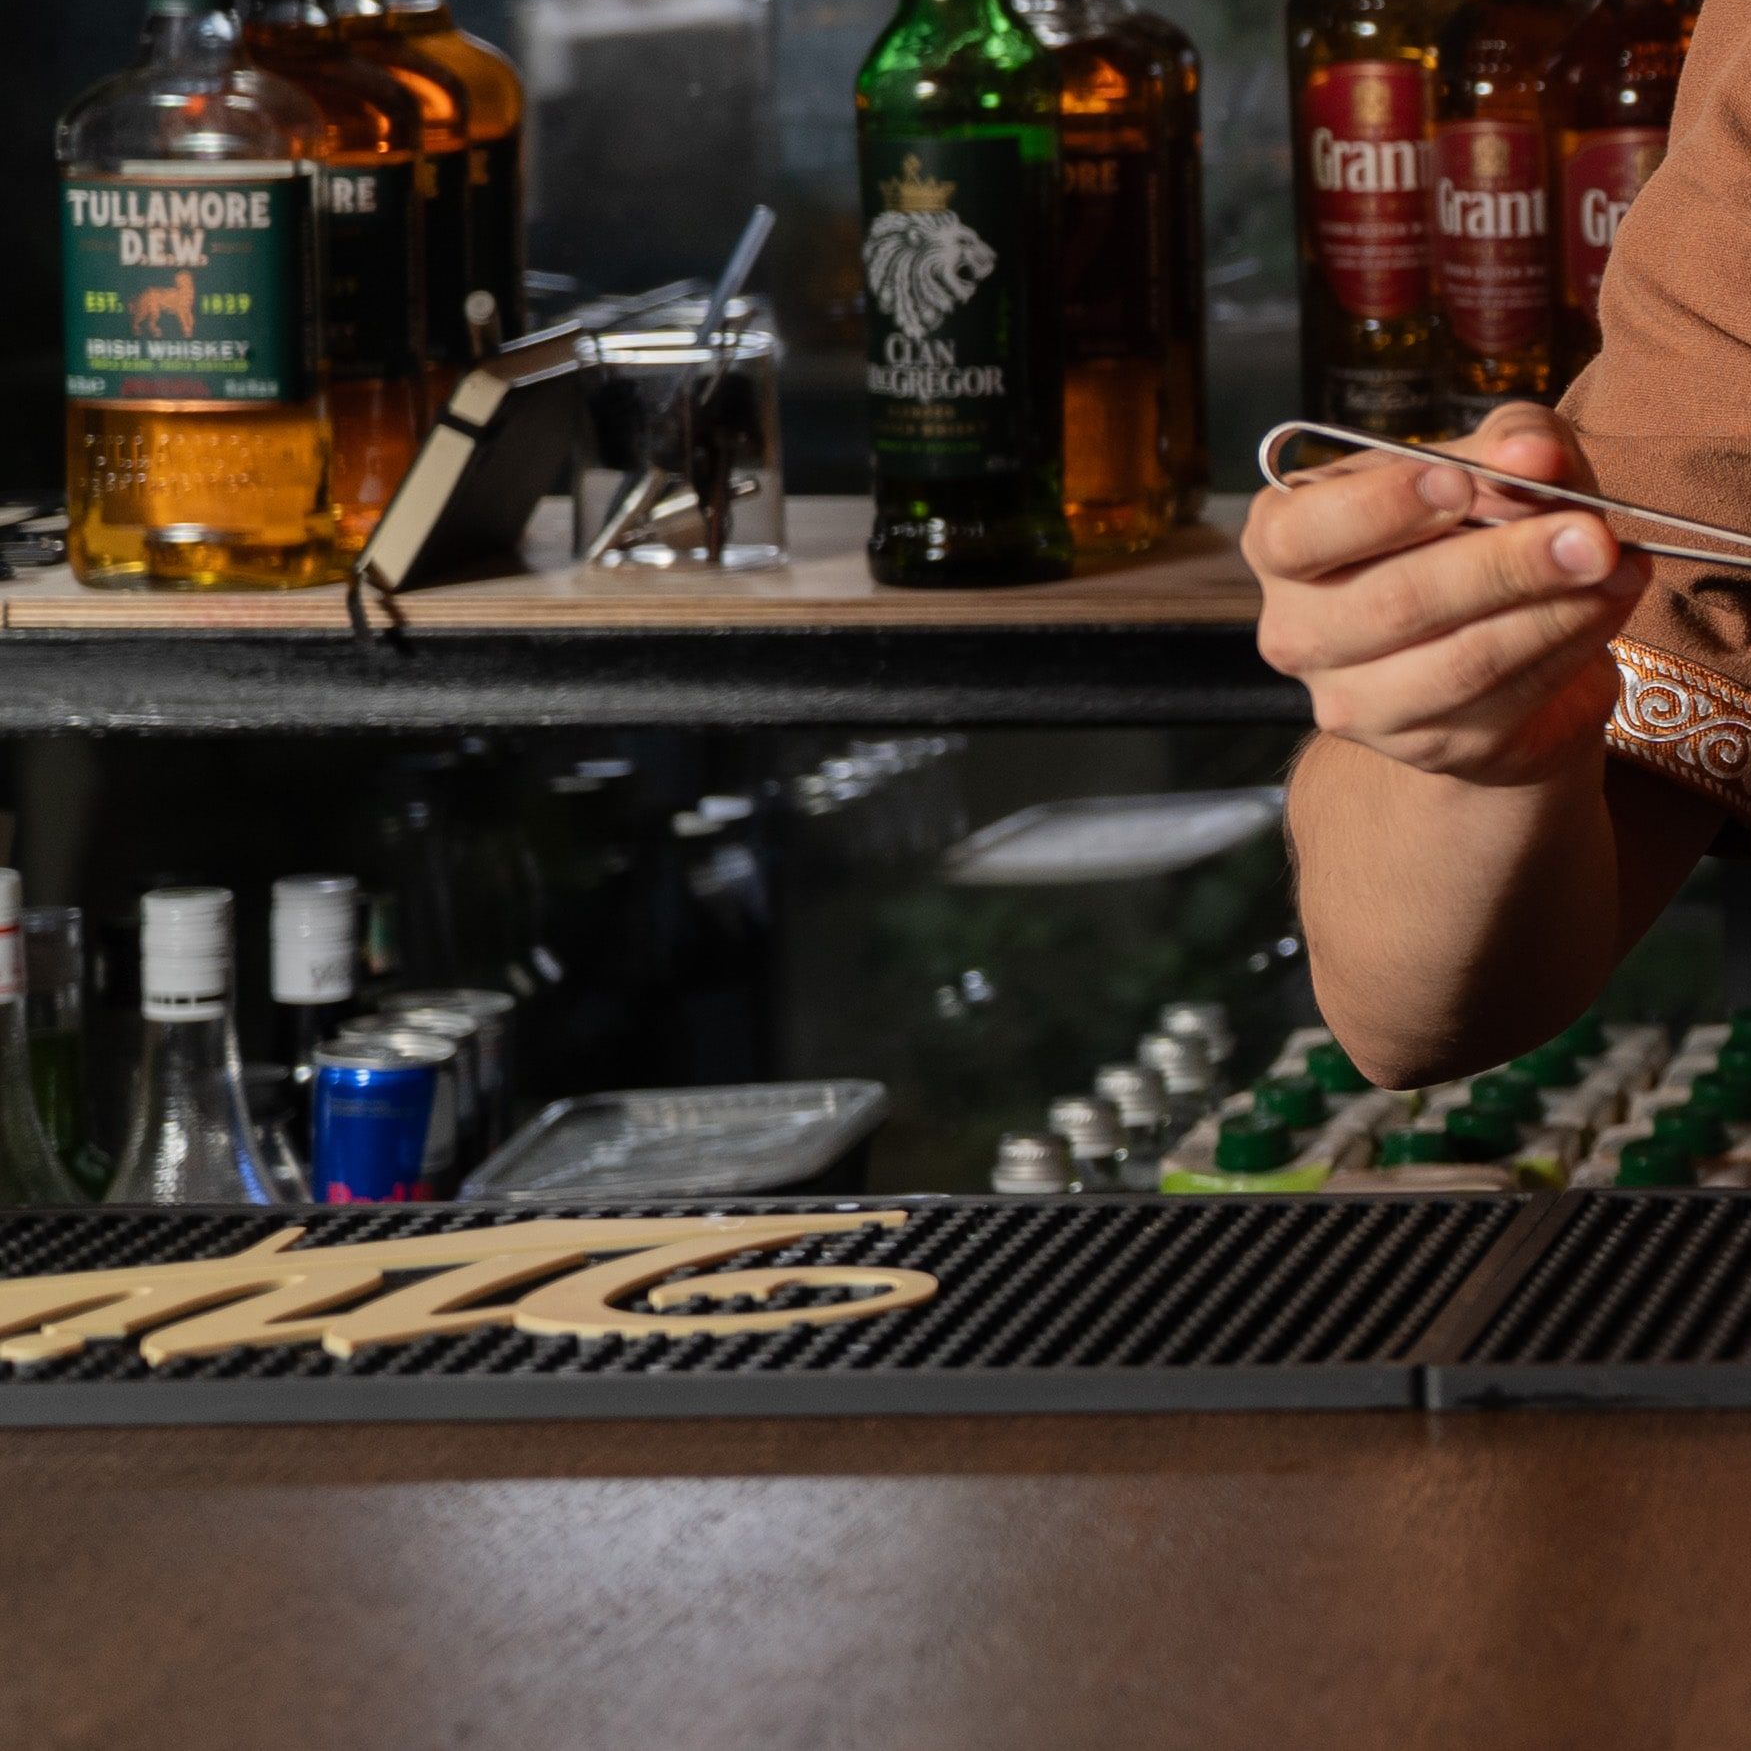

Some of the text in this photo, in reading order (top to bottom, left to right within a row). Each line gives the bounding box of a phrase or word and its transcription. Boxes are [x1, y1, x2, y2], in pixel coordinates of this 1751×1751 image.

[67, 189, 271, 228] TULLAMORE
[86, 338, 250, 361] IRISH WHISKEY
